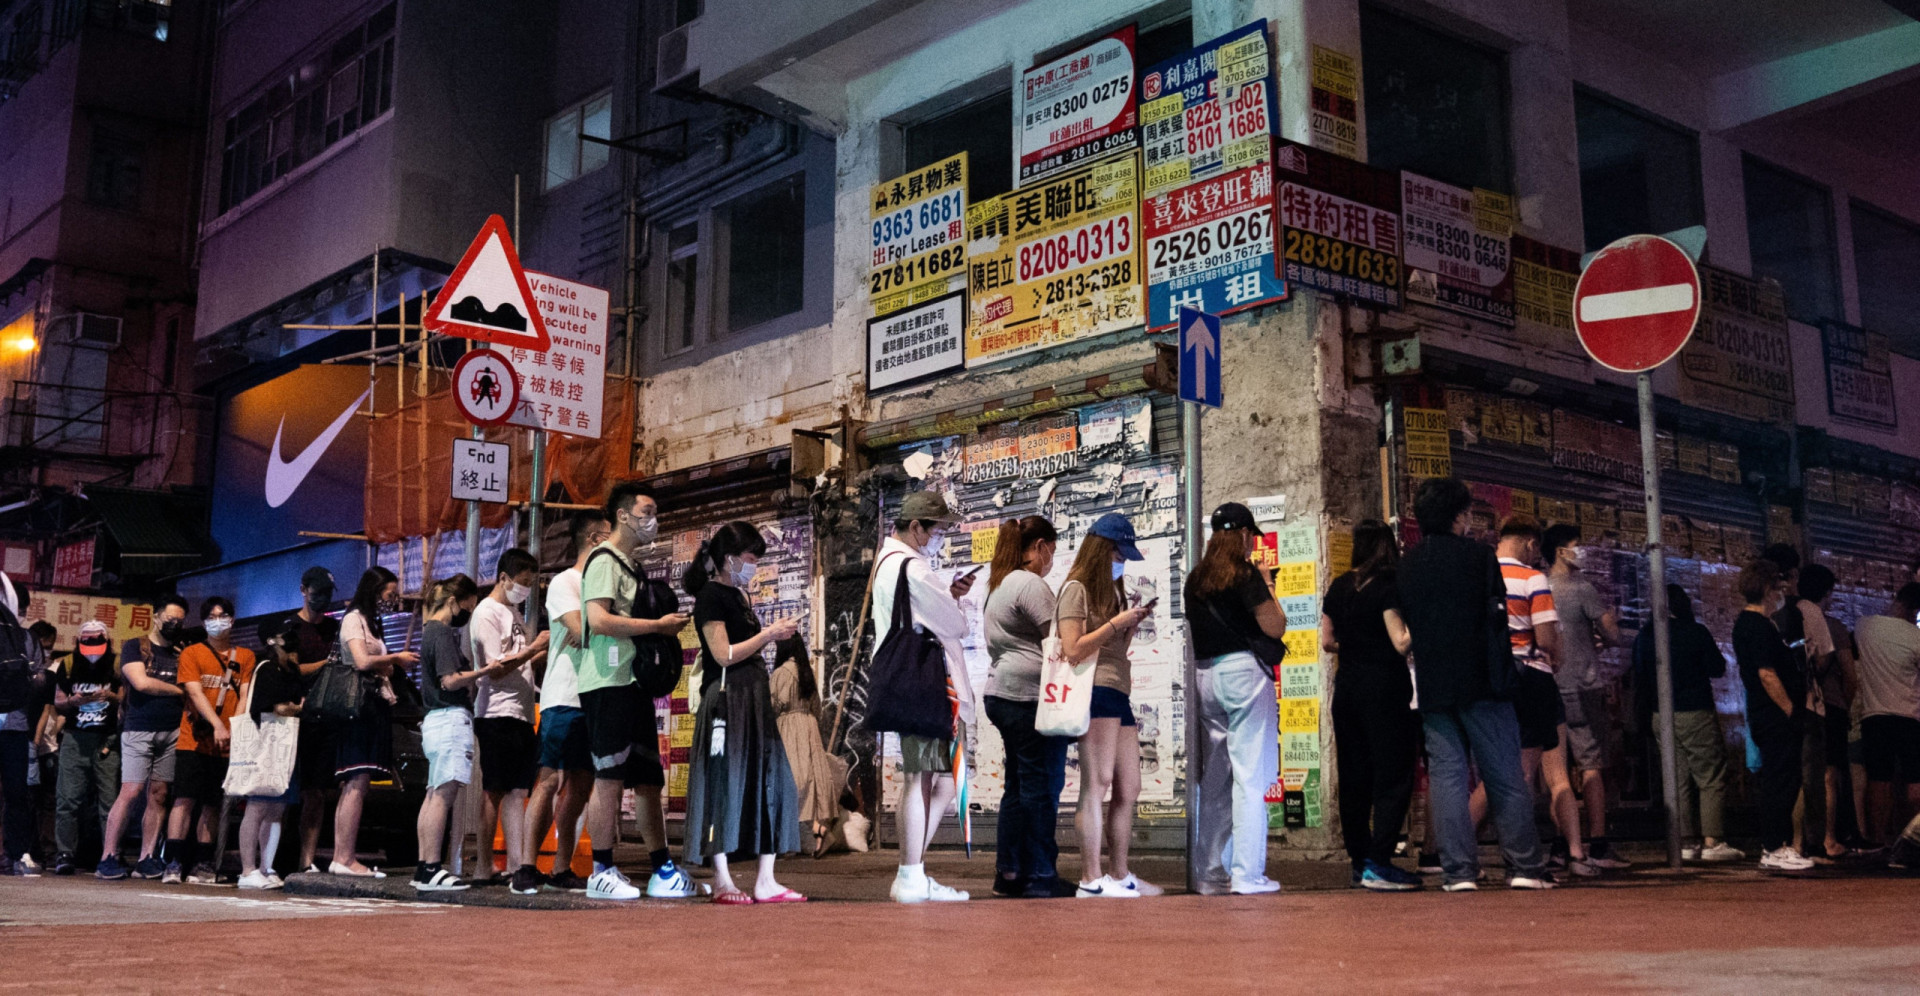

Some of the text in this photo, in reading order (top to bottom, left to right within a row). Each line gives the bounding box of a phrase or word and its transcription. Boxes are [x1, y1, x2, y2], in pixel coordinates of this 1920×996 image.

[1225, 64, 1266, 84] 9703 6826
[1053, 92, 1087, 119] 8300
[1092, 75, 1128, 104] 0275
[1144, 102, 1179, 118] 9150 2181
[1186, 100, 1222, 131] 8228
[1313, 112, 1357, 142] 2770 8819
[1071, 141, 1100, 160] 2810
[1104, 129, 1134, 148] 6066
[1188, 124, 1222, 155] 8101
[1228, 107, 1265, 141] 1686
[1228, 151, 1247, 164] 6108
[891, 159, 962, 206] 永昇物業
[1149, 167, 1187, 186] 6533 6223
[873, 190, 962, 246] 9363 6681
[1283, 185, 1396, 254] 特約租售
[873, 220, 962, 267] 出 For Lease 租
[1020, 215, 1130, 281] 8208-0313
[1154, 226, 1211, 269] 2526
[1217, 208, 1272, 250] 0267
[1436, 222, 1469, 245] 8300
[1474, 234, 1506, 256] 0275
[1437, 239, 1470, 261] 8300
[871, 245, 964, 294] 27811682
[1205, 251, 1231, 268] 9018
[1235, 243, 1262, 260] 7672
[1285, 230, 1398, 286] 28381633
[530, 278, 577, 300] Vehicle
[972, 253, 1014, 295] 陳自立
[1225, 269, 1263, 306] 租
[558, 304, 580, 317] will
[583, 308, 597, 321] be
[1457, 292, 1513, 317] 2810 6066
[552, 335, 601, 355] warning
[510, 346, 585, 376] 停車等候
[516, 372, 583, 402] 會被檢控
[518, 400, 590, 429] 不予警告
[1405, 411, 1447, 429] 2770 8819
[1027, 431, 1071, 449] 2300 1388
[968, 455, 1019, 482] 23326297
[1021, 451, 1076, 479] 23326297
[1408, 457, 1450, 475] 2770 8819
[460, 469, 500, 492] 終止
